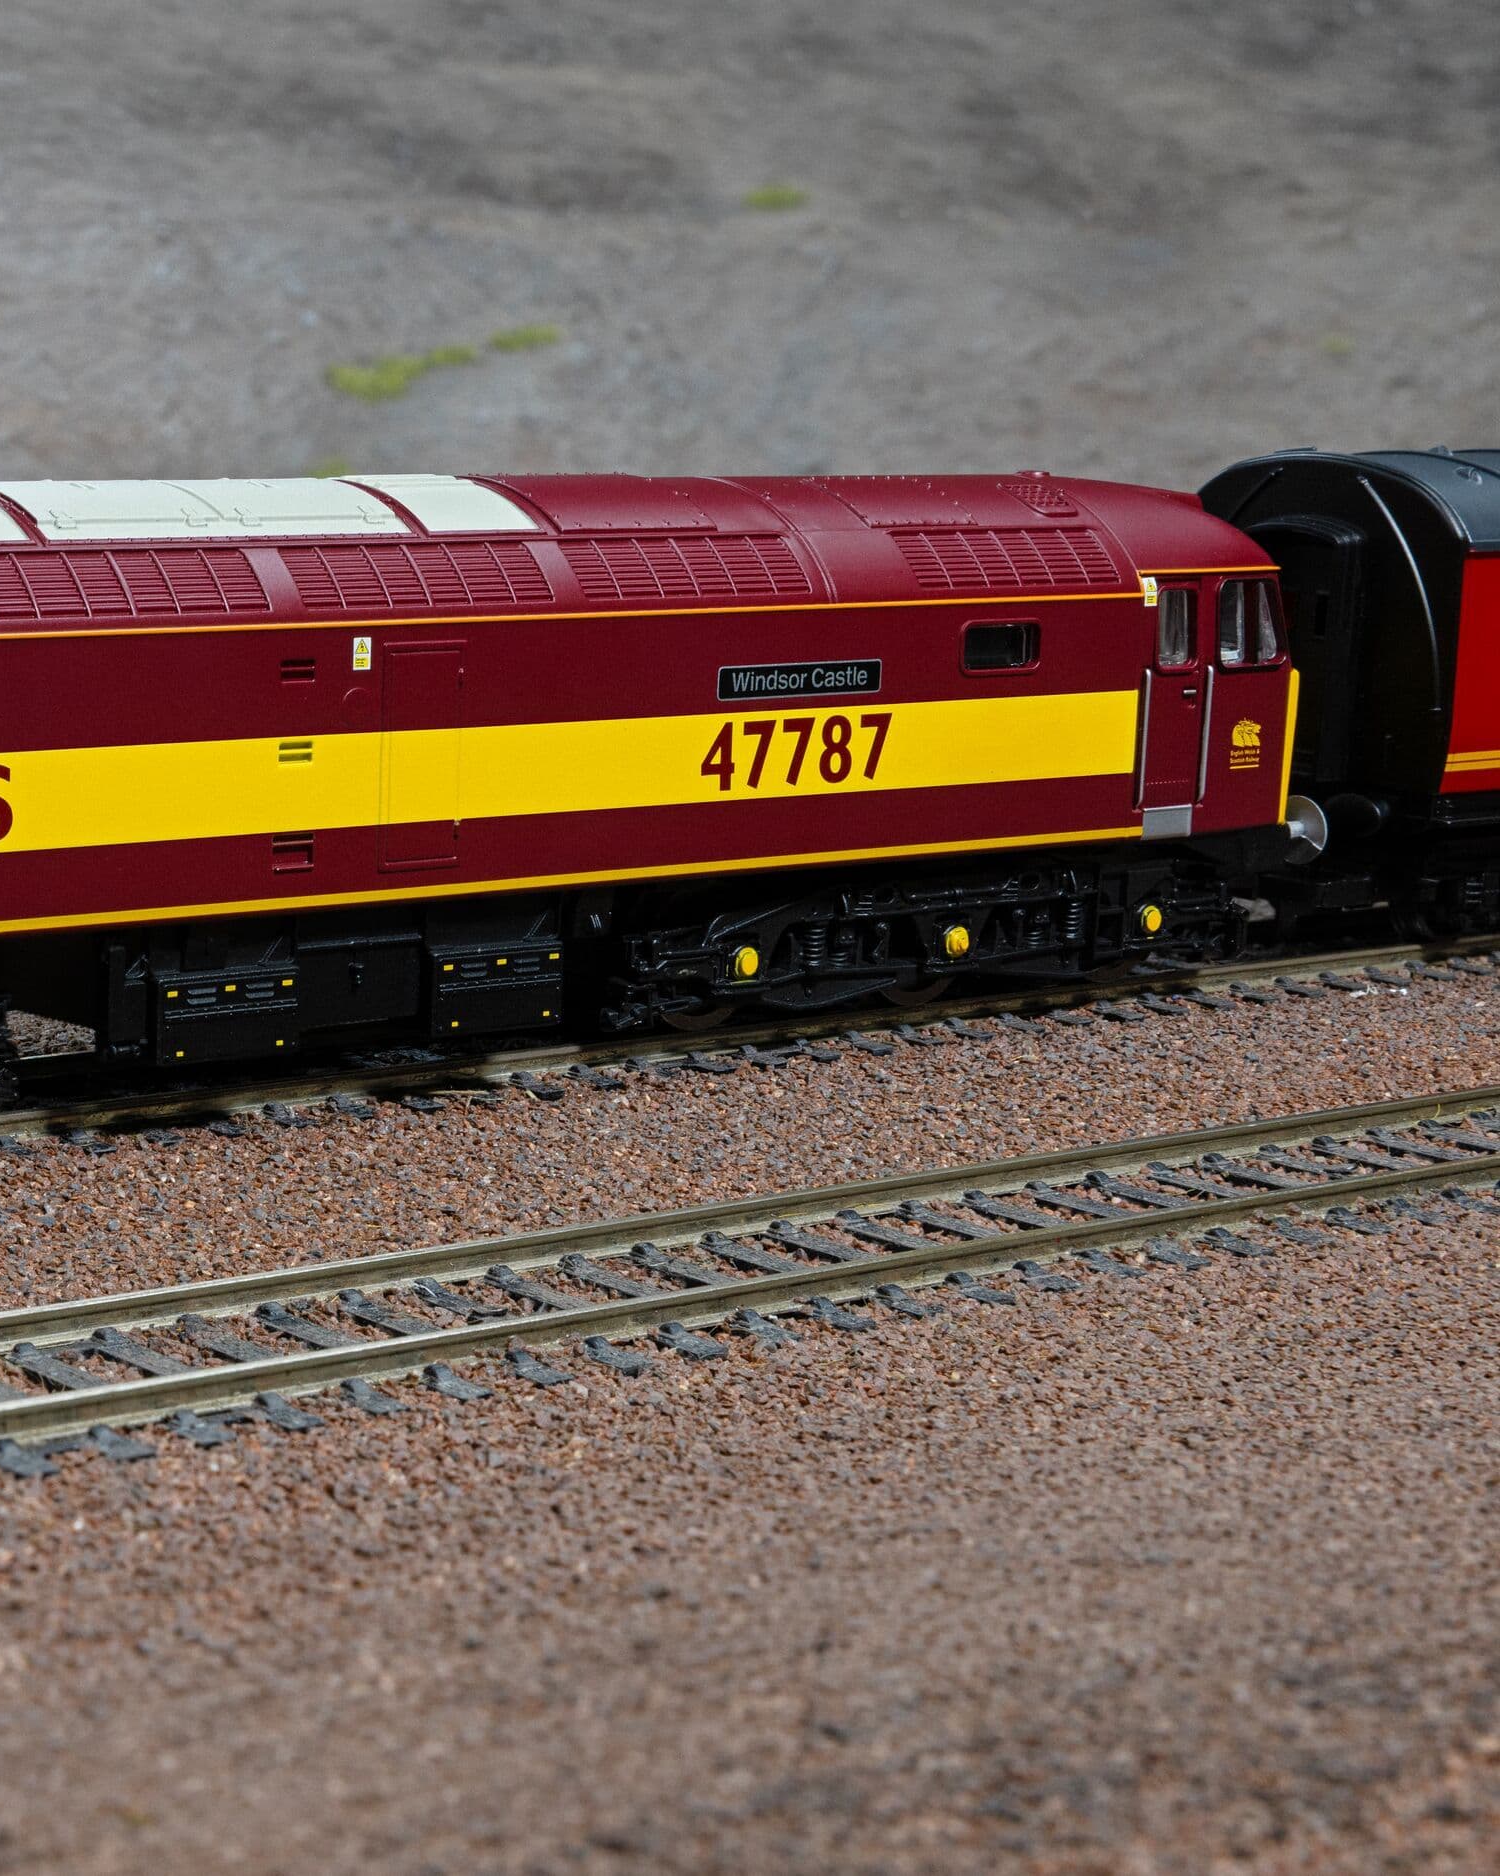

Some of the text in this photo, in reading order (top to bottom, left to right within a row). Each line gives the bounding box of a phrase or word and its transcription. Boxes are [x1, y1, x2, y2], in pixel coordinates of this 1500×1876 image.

[732, 666, 868, 692] Windsor Castle
[701, 712, 893, 791] 47787
